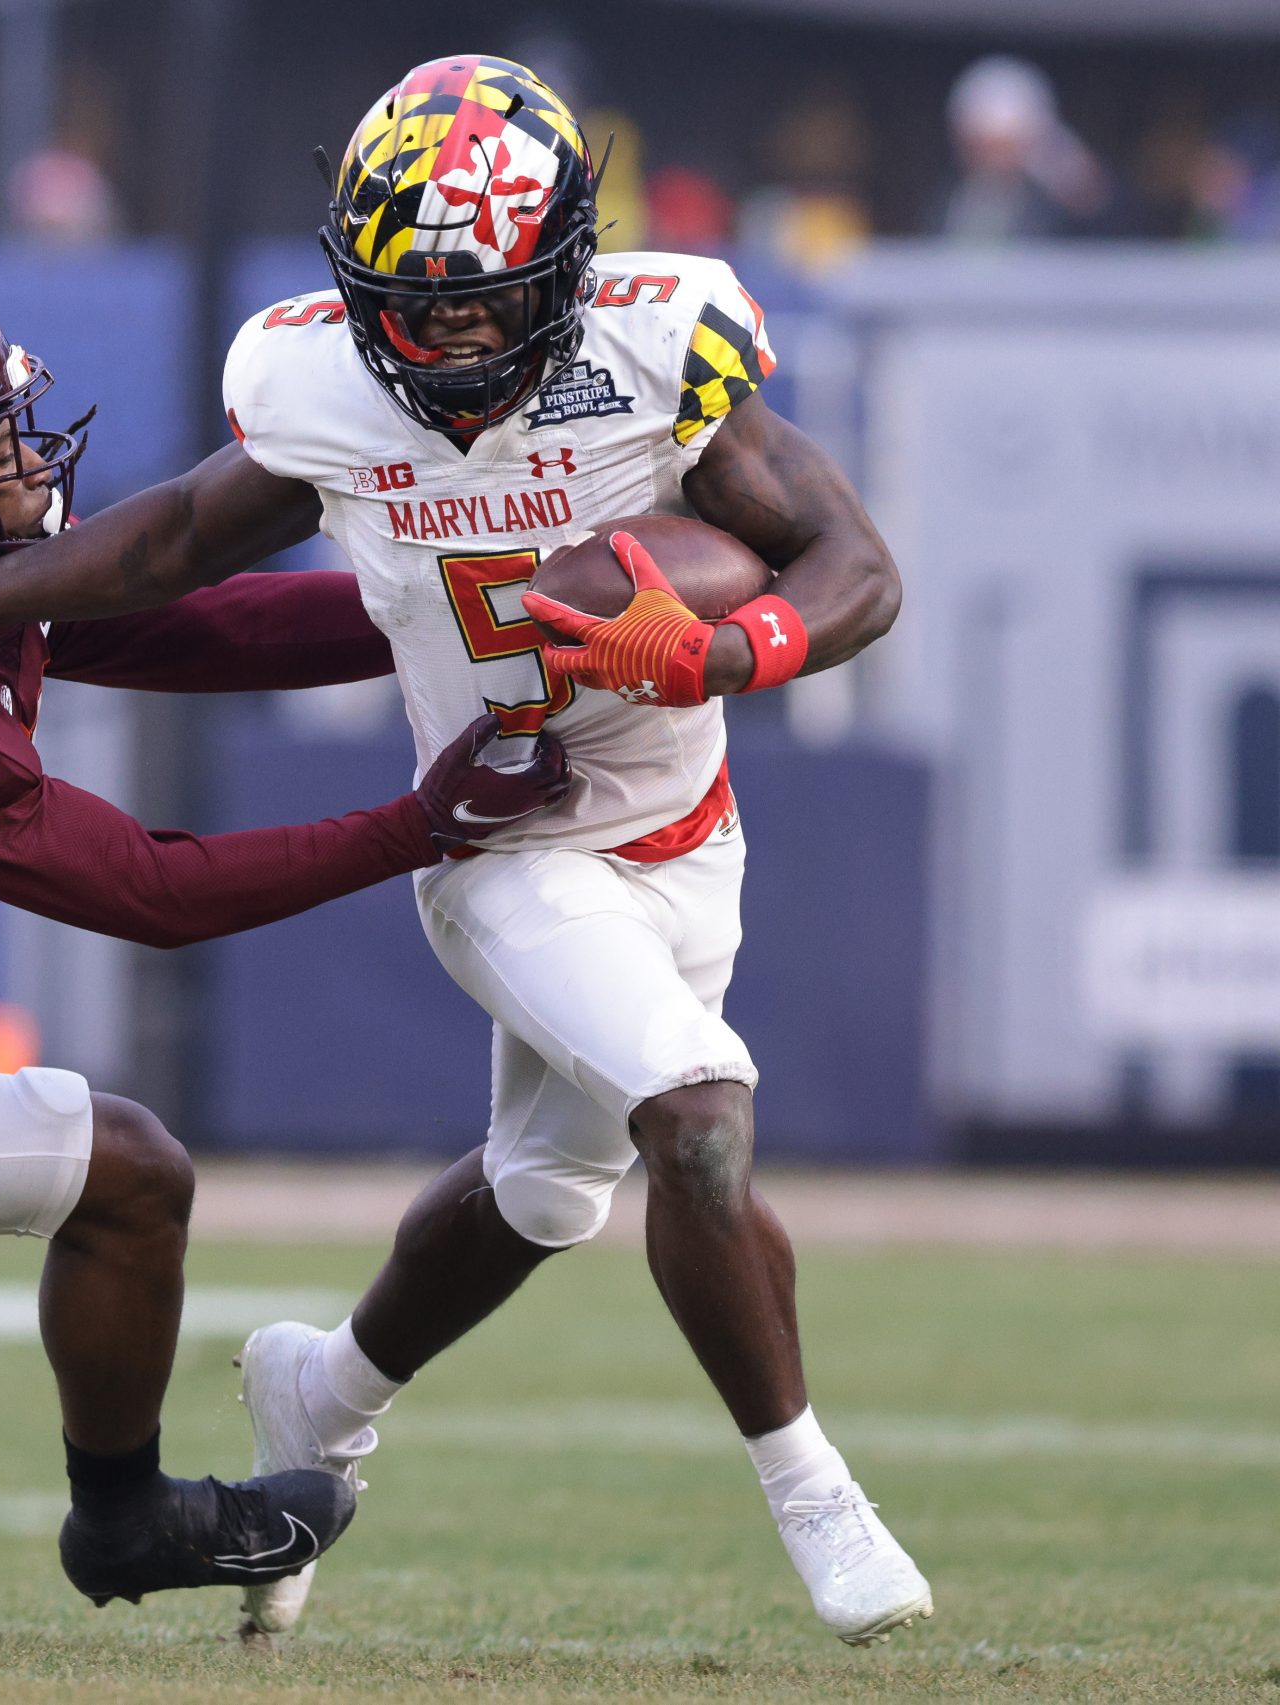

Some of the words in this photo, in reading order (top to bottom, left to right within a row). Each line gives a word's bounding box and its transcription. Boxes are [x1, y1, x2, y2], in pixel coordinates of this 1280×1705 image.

[425, 256, 447, 278] M
[593, 274, 680, 308] 5
[263, 301, 346, 330] 5
[544, 385, 611, 408] PINSTRIPE
[562, 401, 597, 416] BOWL
[385, 488, 573, 540] MARYLAND
[437, 547, 575, 740] 5
